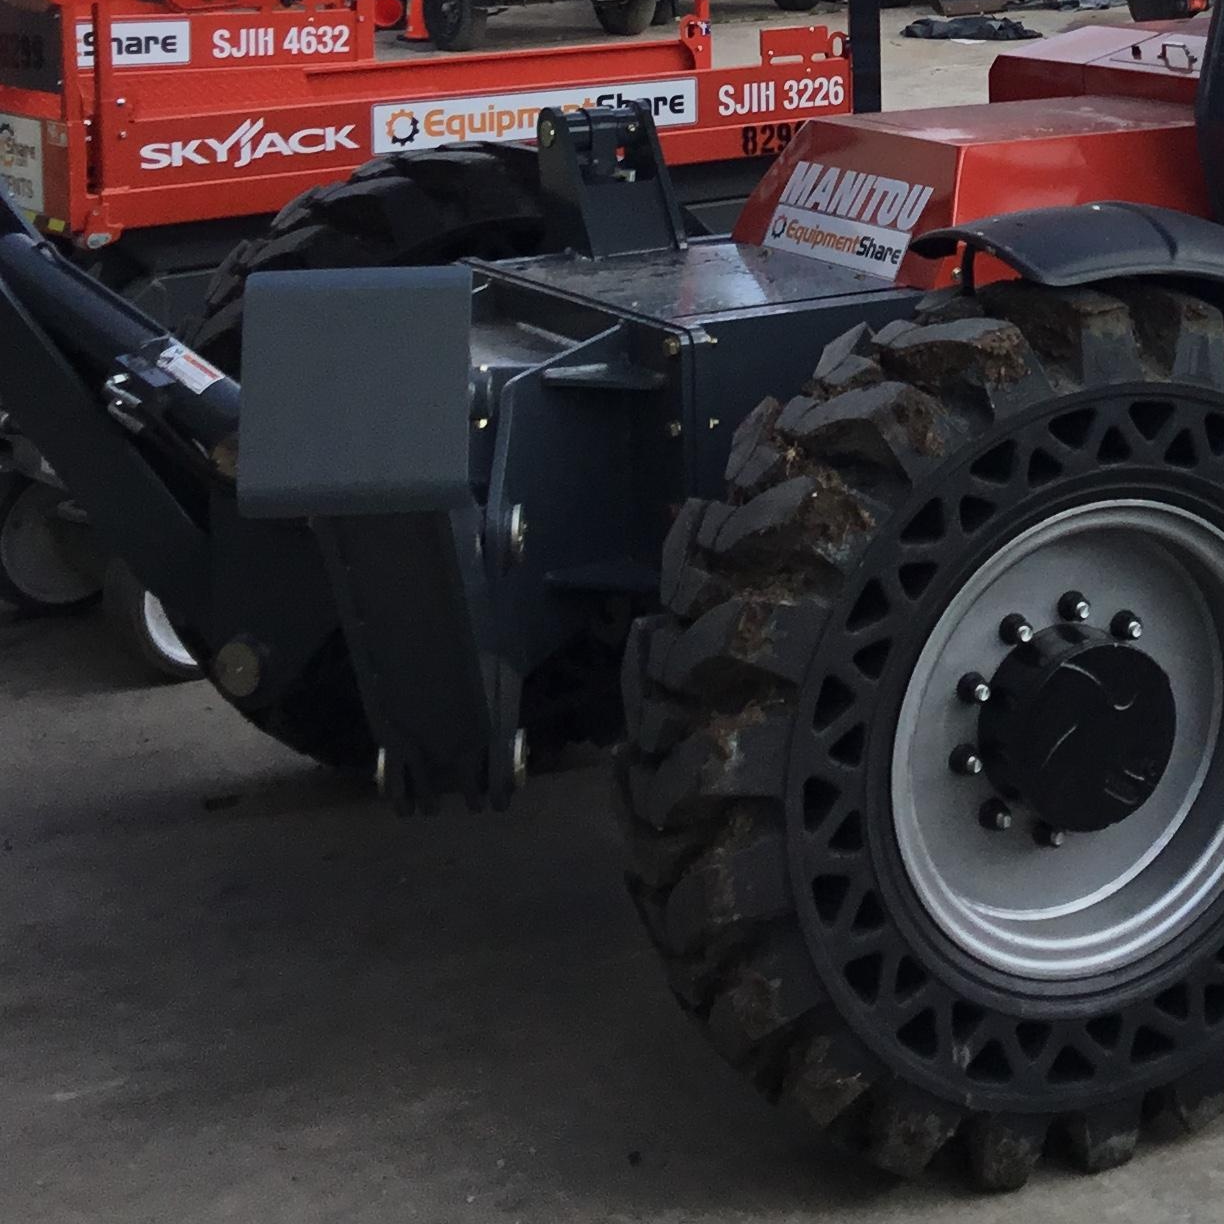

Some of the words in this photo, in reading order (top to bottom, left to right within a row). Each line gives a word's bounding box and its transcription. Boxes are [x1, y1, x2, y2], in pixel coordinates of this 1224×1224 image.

[283, 25, 350, 55] 4632
[783, 76, 844, 110] 3226
[140, 117, 360, 169] SKYJACK
[778, 160, 935, 230] MANITOU
[786, 219, 902, 265] EquipmentShare
